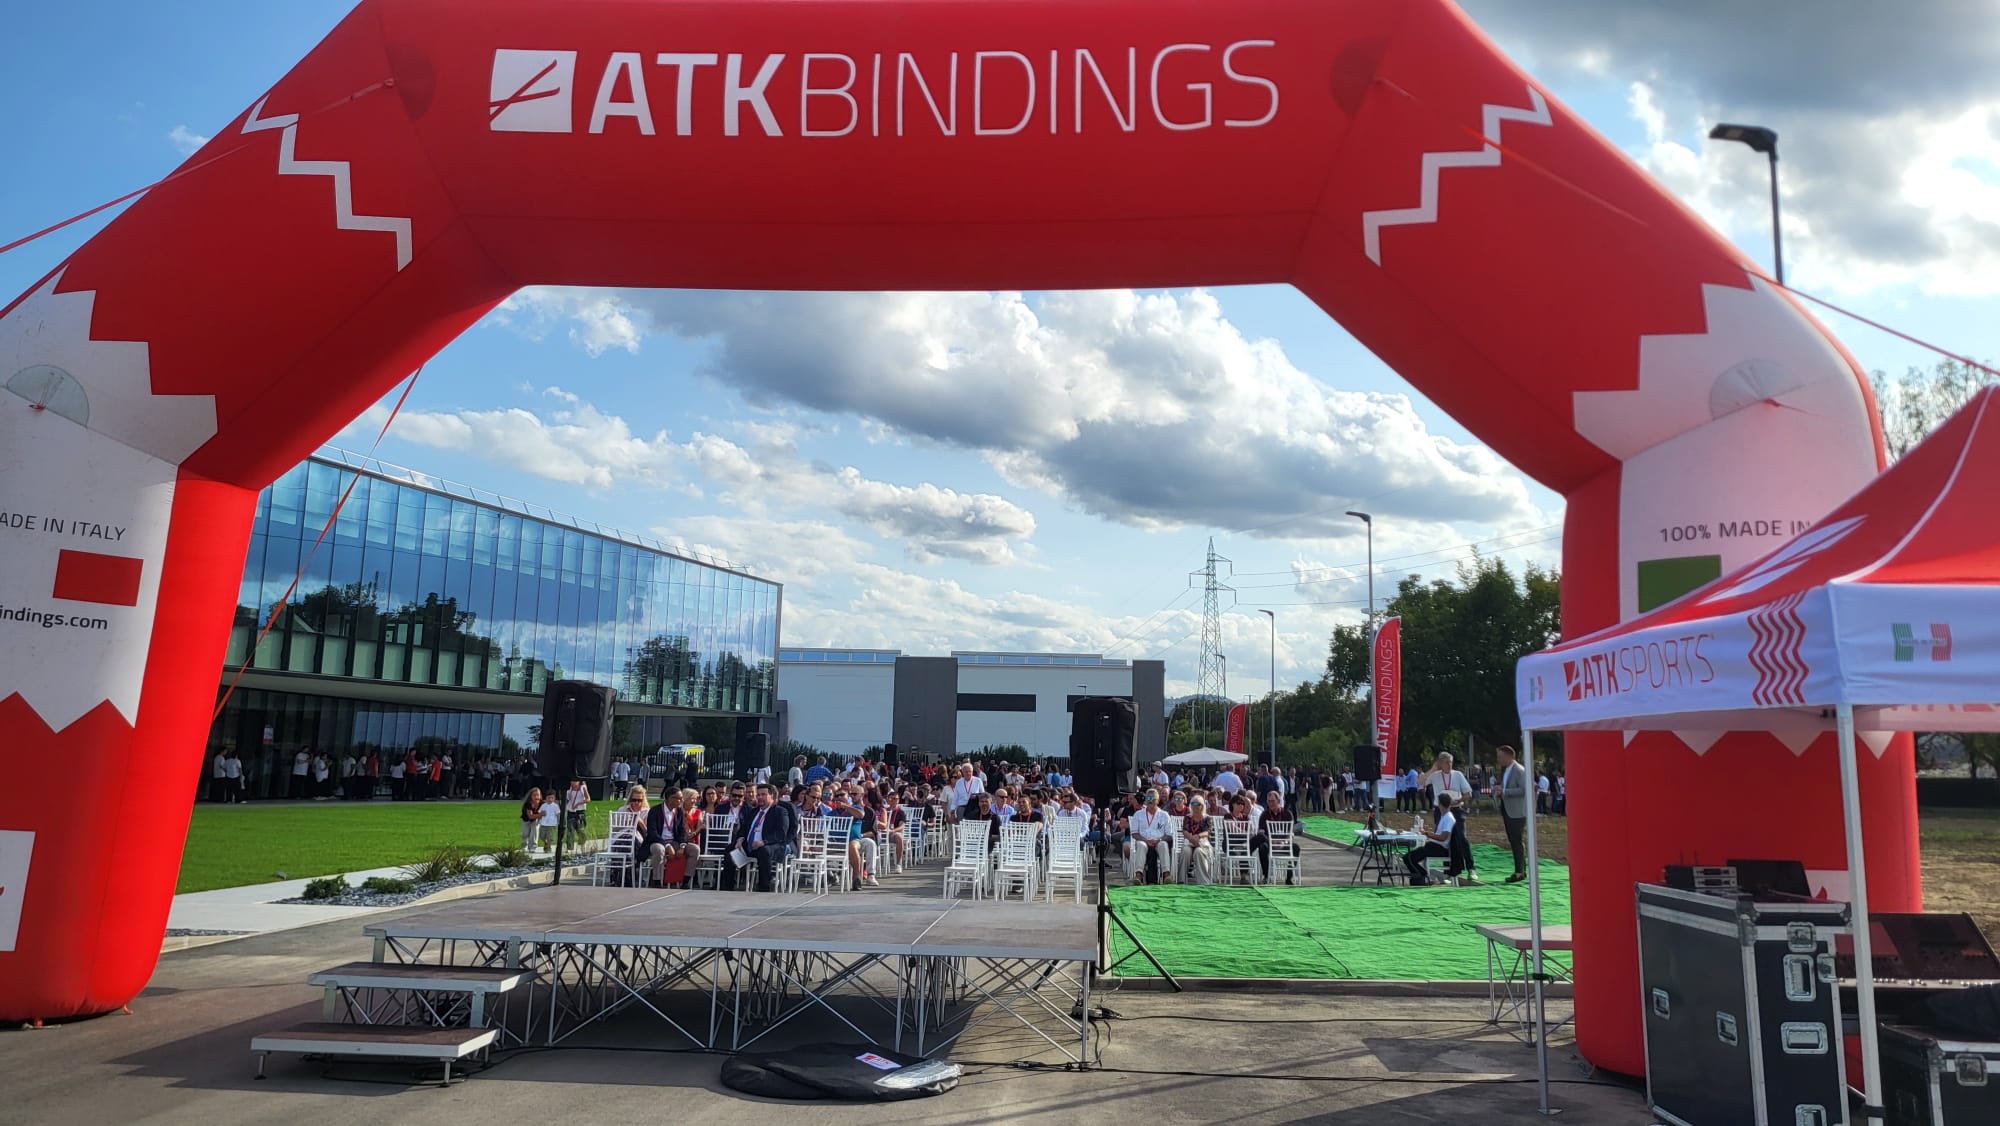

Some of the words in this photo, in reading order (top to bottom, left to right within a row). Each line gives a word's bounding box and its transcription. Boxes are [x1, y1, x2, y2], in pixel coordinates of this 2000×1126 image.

[588, 39, 1279, 138] ATKBINDINGS
[0, 512, 38, 531] ADE
[43, 516, 65, 534] IN
[71, 520, 127, 542] ITALY
[1659, 524, 1712, 543] 100%
[1719, 520, 1783, 538] MADE
[0, 605, 109, 630] indings.com
[1583, 633, 1716, 700] ATKSPORTS
[1376, 638, 1394, 748] ATKBINDINGS
[1229, 712, 1241, 752] BINDINGS
